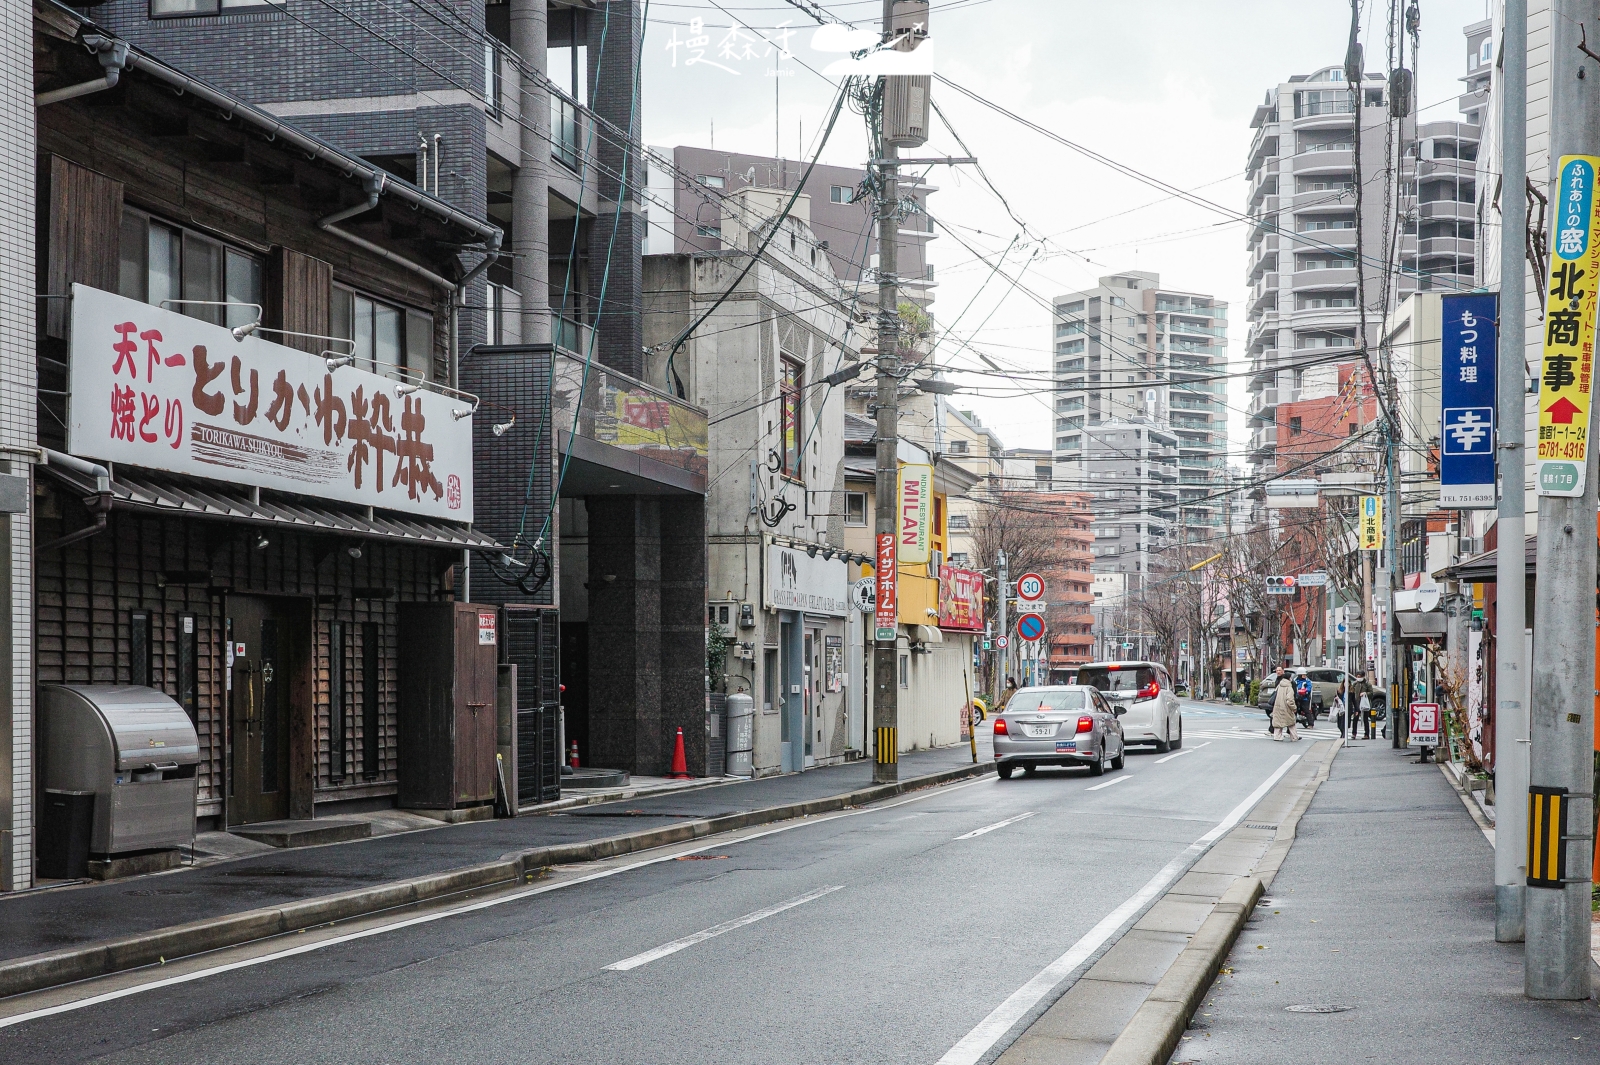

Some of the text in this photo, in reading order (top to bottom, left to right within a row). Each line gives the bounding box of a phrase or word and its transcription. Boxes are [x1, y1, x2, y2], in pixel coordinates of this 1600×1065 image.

[1558, 163, 1585, 255] ふれあいの窓
[112, 321, 186, 384] 天下一
[1459, 309, 1478, 384] もつ料理
[1543, 262, 1585, 392] 北商事
[110, 382, 184, 450] 焼とり
[1446, 410, 1492, 451] 幸
[1545, 441, 1585, 459] 781-4316
[902, 480, 920, 545] MILAN
[918, 502, 926, 552] RESTAURANT
[1366, 517, 1376, 544] 北商事
[881, 535, 894, 609] タイザンホーム
[1023, 580, 1039, 594] 30
[1019, 603, 1044, 611] ここまで
[1412, 705, 1437, 732] 酒
